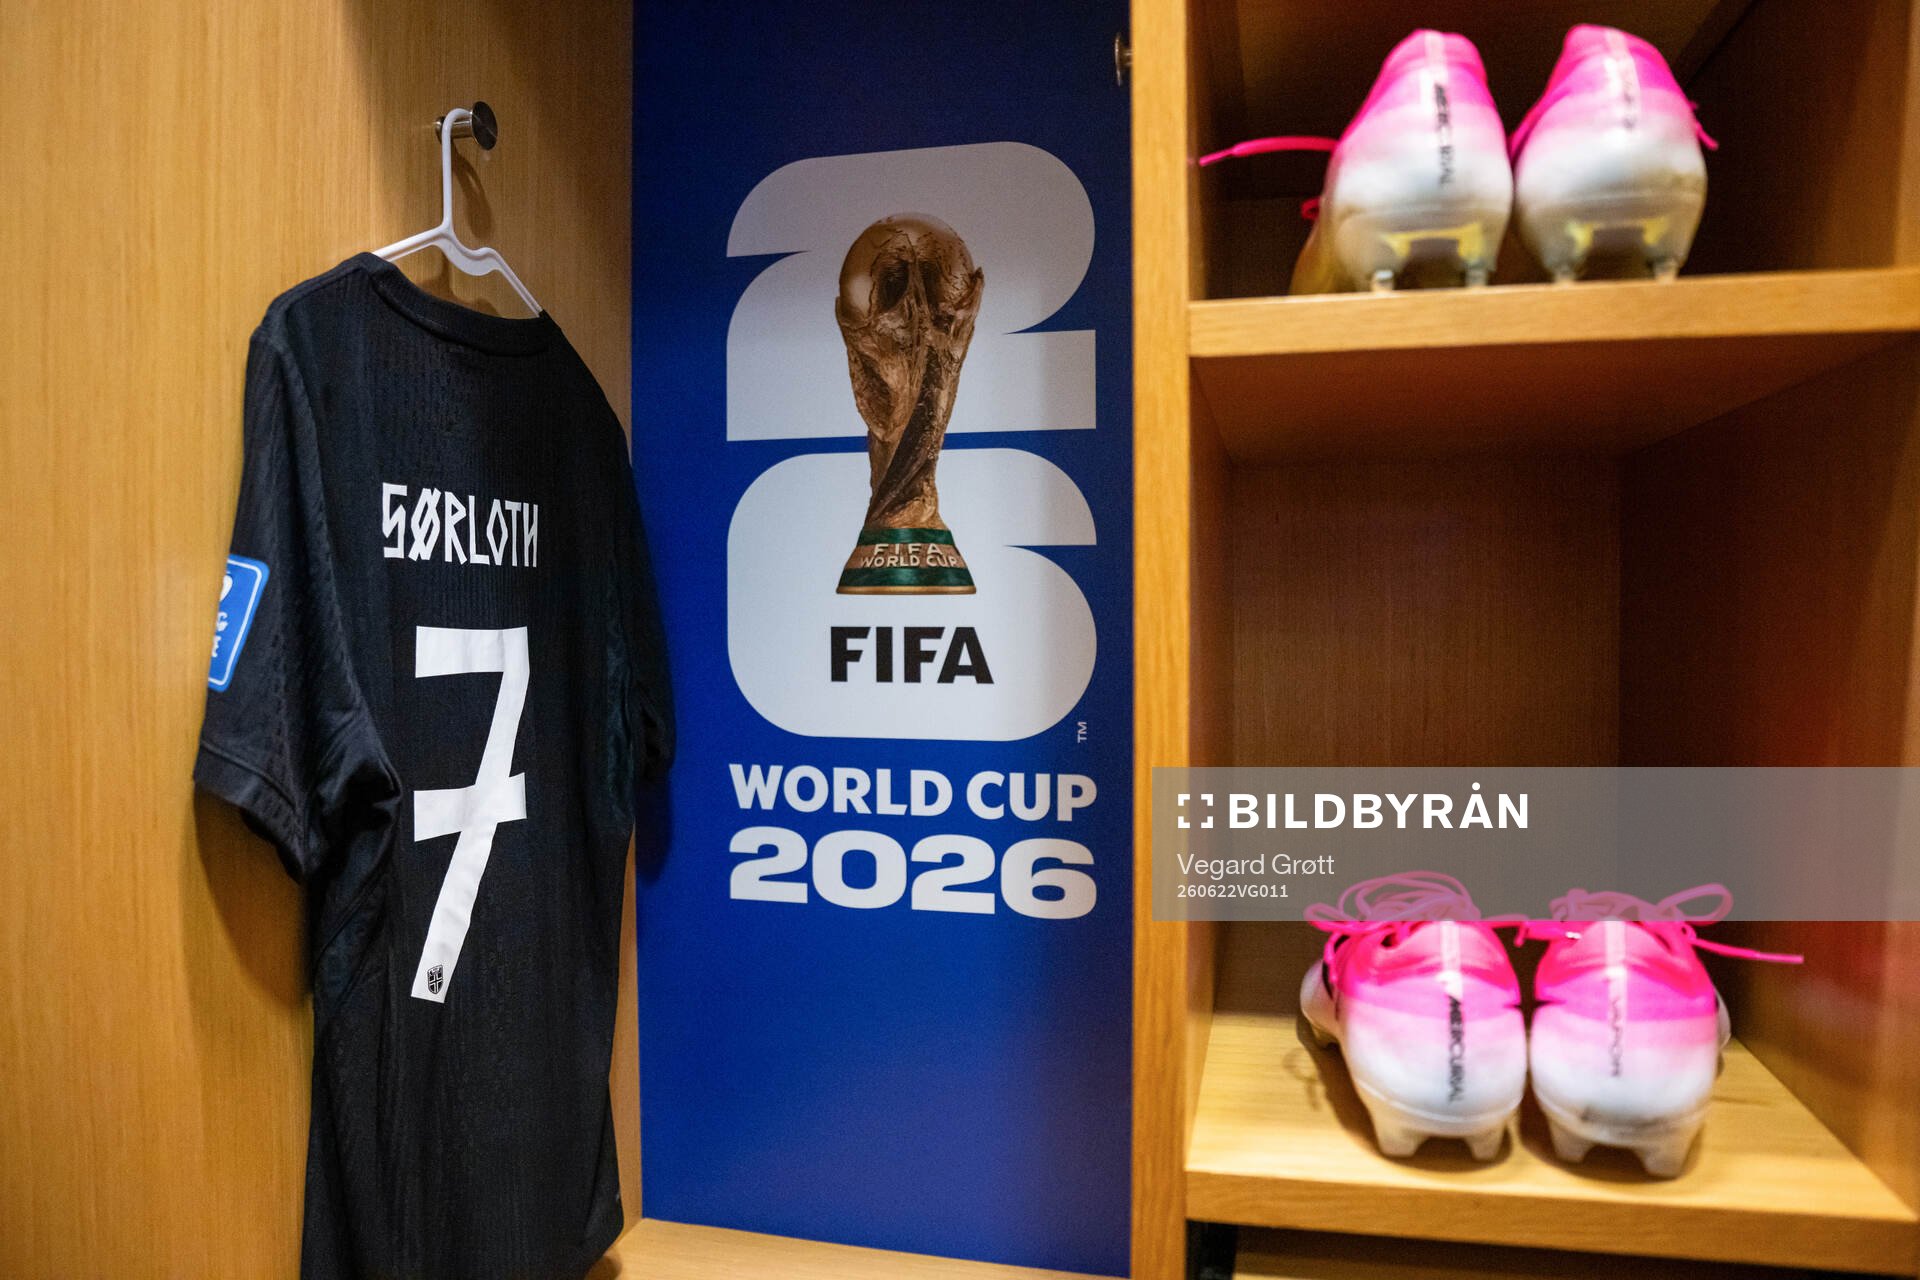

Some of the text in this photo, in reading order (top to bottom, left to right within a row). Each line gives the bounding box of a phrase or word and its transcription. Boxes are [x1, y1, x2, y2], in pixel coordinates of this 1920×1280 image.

[382, 482, 538, 568] SØRLOTH
[874, 543, 943, 556] FIFA
[861, 555, 958, 568] WORLD CUP
[830, 626, 995, 684] FIFA
[411, 626, 530, 1004] 7
[728, 763, 1098, 822] WORLD CUP
[729, 826, 1097, 920] 2026
